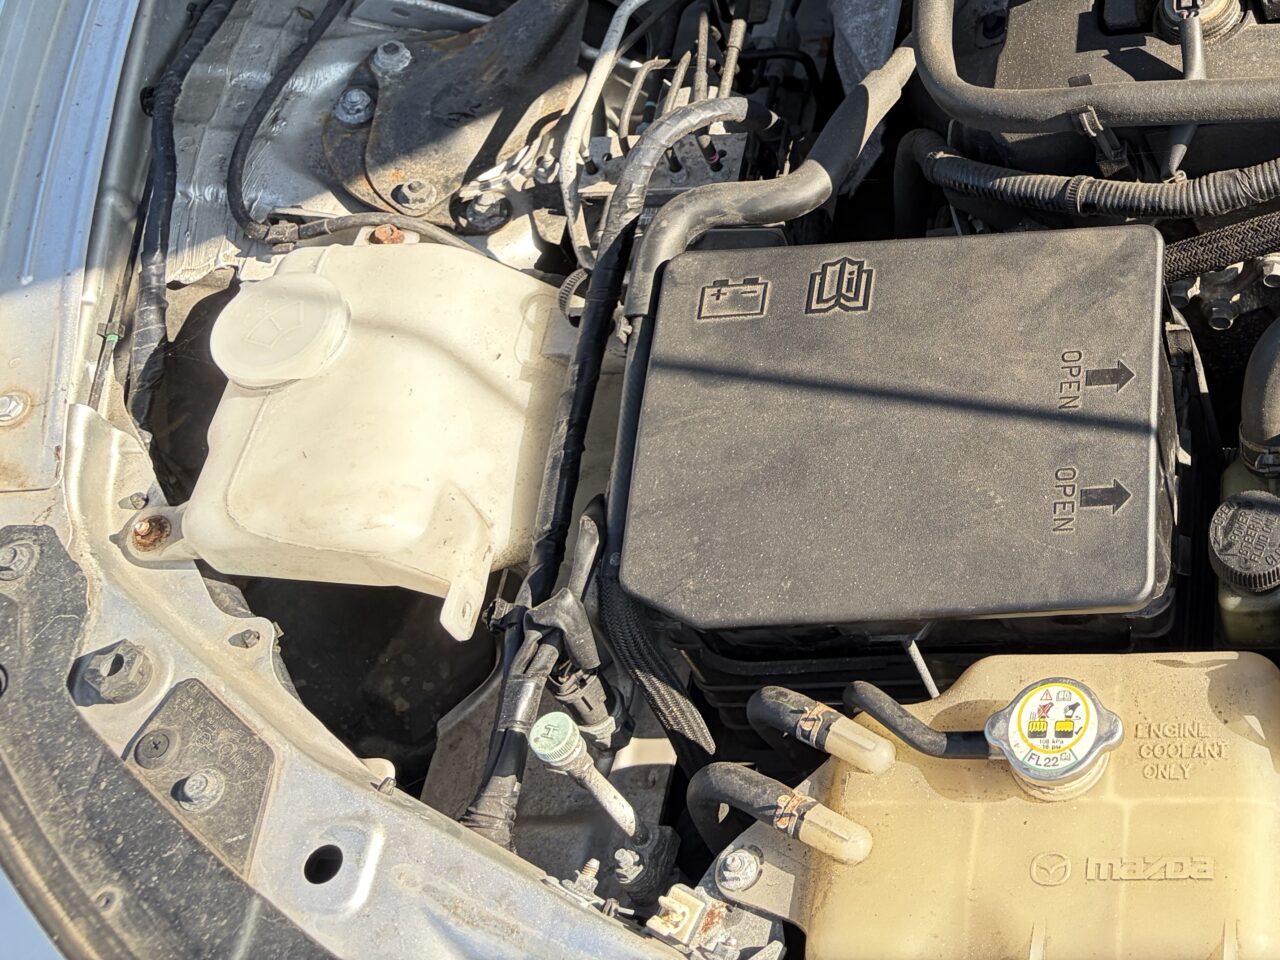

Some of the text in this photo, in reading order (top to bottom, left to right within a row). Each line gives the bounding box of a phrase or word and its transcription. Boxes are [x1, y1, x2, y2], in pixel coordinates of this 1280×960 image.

[1059, 350, 1083, 410] OPEN
[1052, 467, 1077, 532] OPEN
[1230, 510, 1250, 543] POWER
[1250, 535, 1271, 564] FLUID
[1134, 721, 1210, 739] ENGINE
[1027, 752, 1060, 768] FL22
[1139, 741, 1228, 760] COOLANT
[1143, 764, 1193, 780] ONLY
[1086, 855, 1215, 882] mazda
